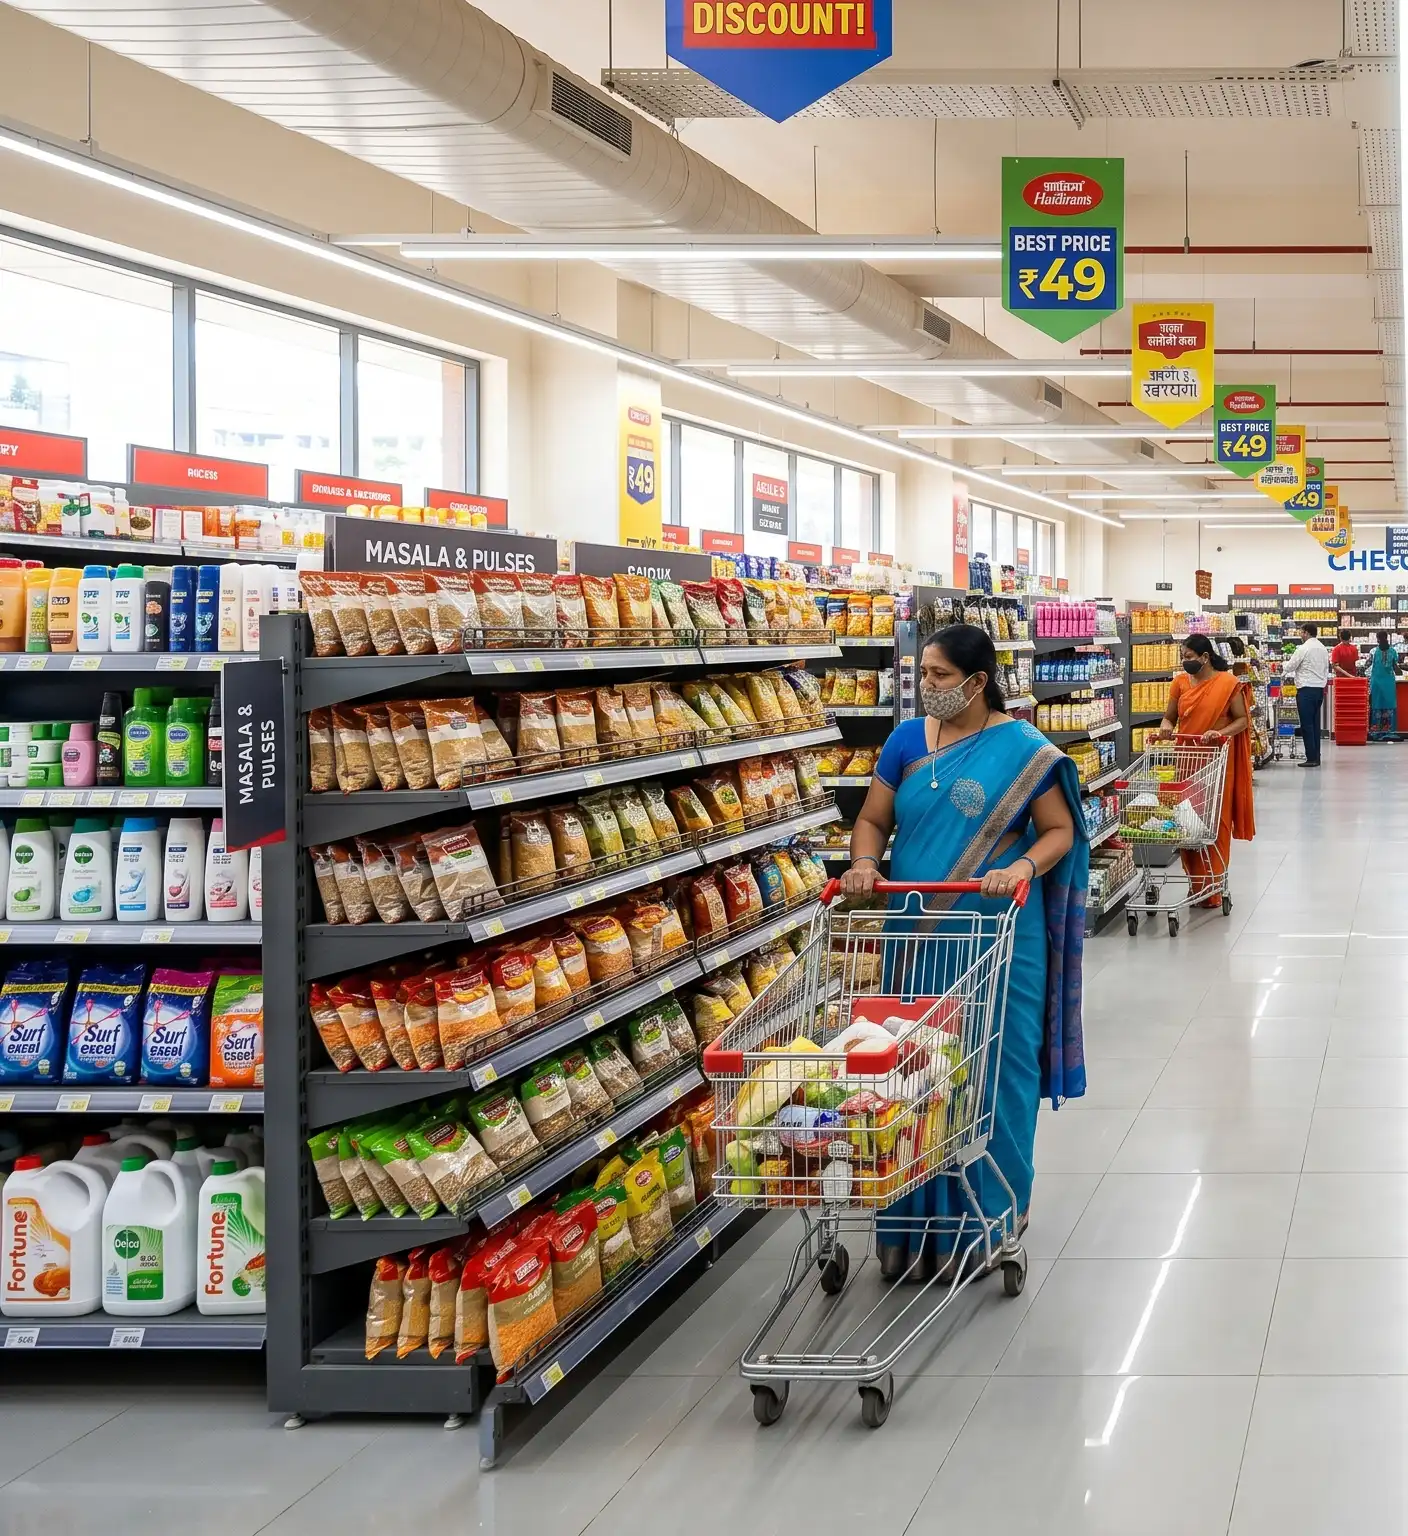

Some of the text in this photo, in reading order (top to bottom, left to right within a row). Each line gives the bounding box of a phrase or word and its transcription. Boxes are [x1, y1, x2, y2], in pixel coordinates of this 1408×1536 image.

[692, 2, 866, 35] DISCOUNT!
[1014, 235, 1111, 252] BEST PRICE
[1018, 258, 1106, 301] ₹49
[1221, 423, 1243, 432] BEST
[1222, 434, 1267, 457] ₹49
[365, 539, 535, 574] MASALA & PULSES
[238, 703, 254, 804] MASALA &
[261, 719, 275, 788] PULSES
[10, 1023, 46, 1042] Surf
[84, 1024, 121, 1043] Surf
[152, 1026, 188, 1045] Surf
[7, 1209, 28, 1292] Fortune
[205, 1211, 226, 1296] Fortune
